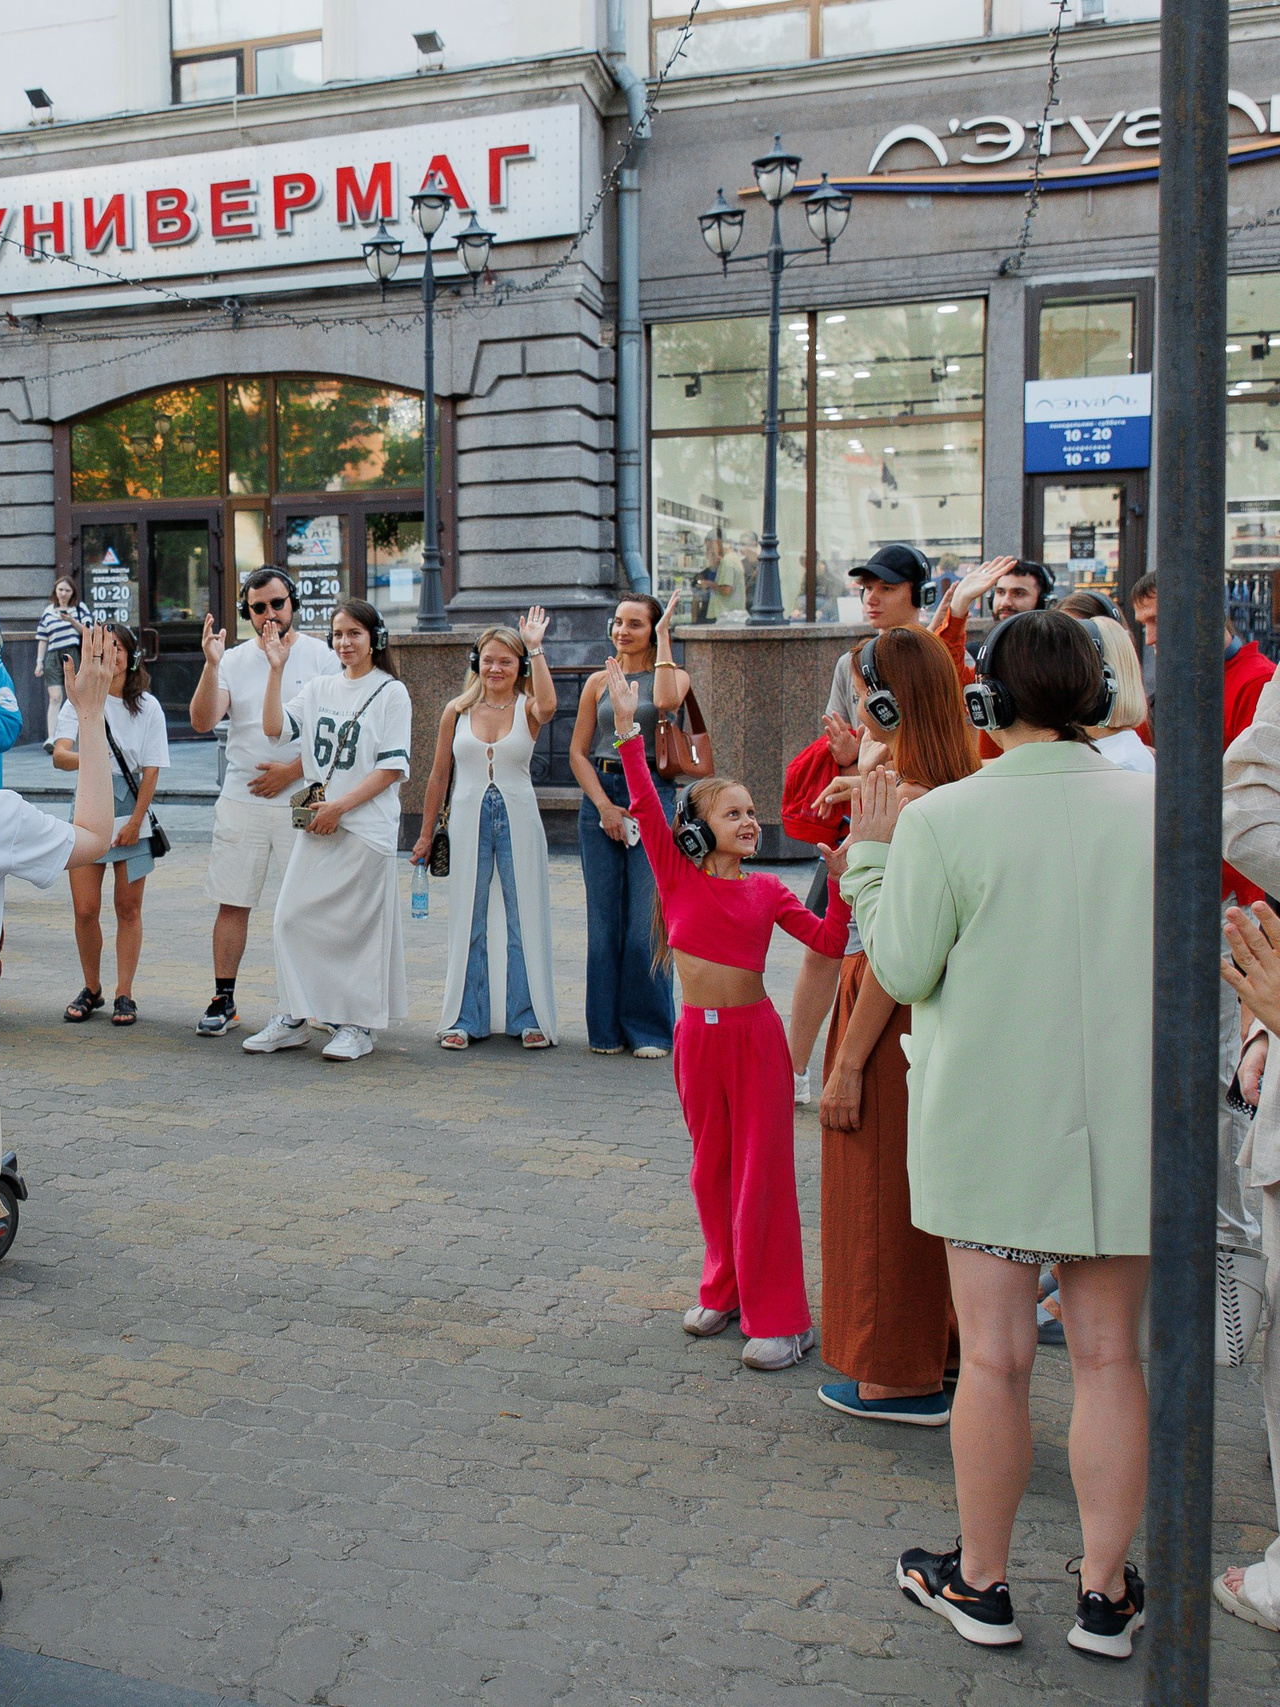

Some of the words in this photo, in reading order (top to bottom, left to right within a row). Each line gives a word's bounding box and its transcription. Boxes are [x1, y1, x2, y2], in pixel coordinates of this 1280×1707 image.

[1063, 429, 1081, 442] 10
[1092, 427, 1112, 441] 20
[1064, 453, 1082, 466] 10
[1093, 451, 1111, 465] 19
[298, 570, 338, 578] ЕЖЕДНЕВНО
[313, 716, 361, 771] 68
